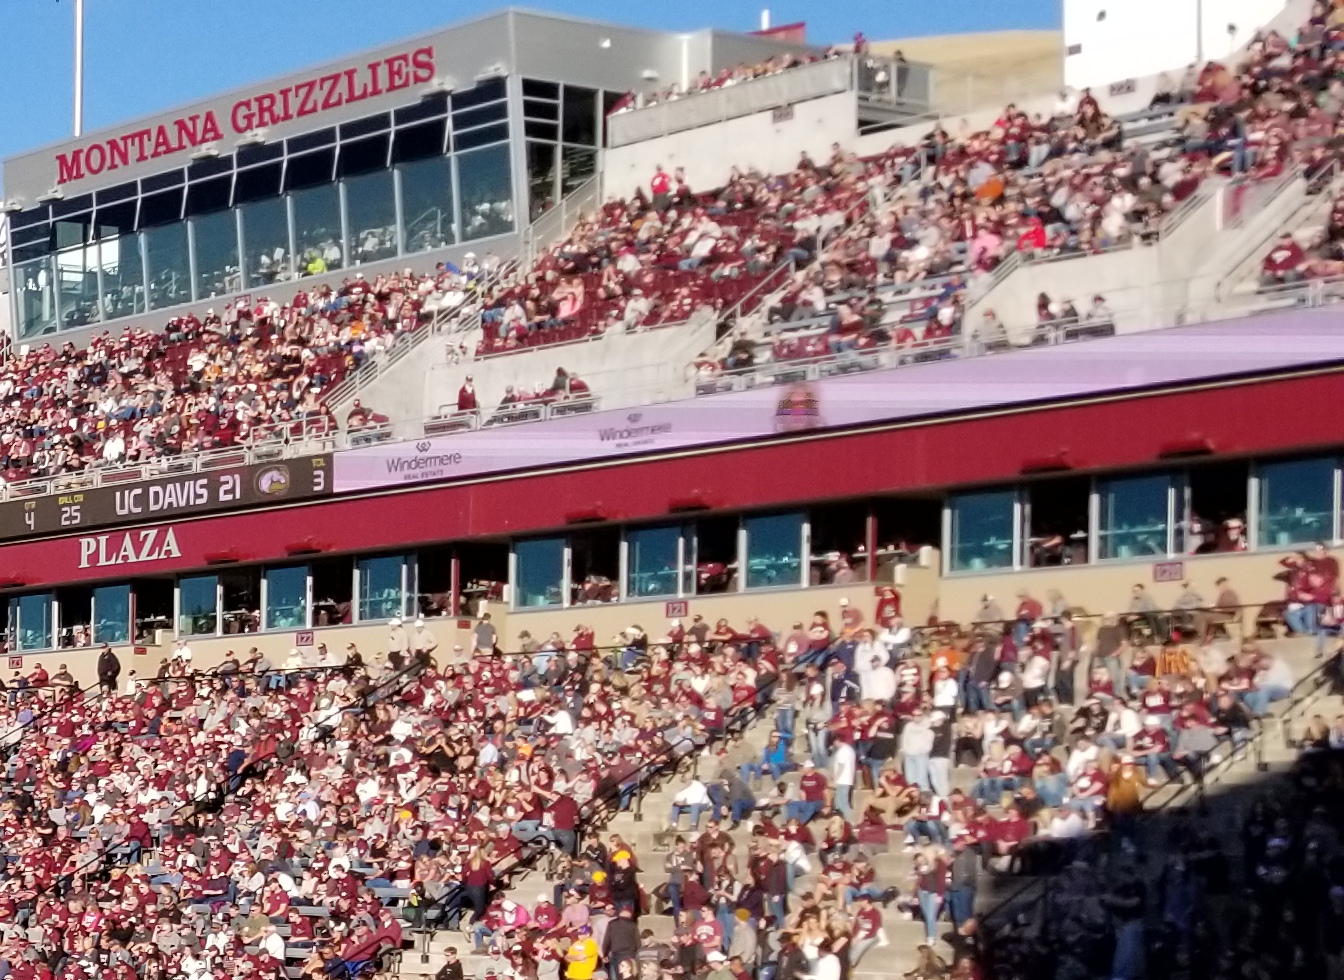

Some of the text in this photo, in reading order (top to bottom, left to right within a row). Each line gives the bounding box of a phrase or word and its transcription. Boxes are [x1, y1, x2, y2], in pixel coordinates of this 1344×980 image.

[55, 46, 436, 184] MONTANA GRIZZLIES
[386, 452, 463, 474] Windermere
[312, 470, 324, 491] 3
[115, 473, 241, 515] UC DAVIS 21
[25, 511, 35, 531] 4
[60, 505, 81, 526] 25
[78, 527, 182, 568] PLAZA
